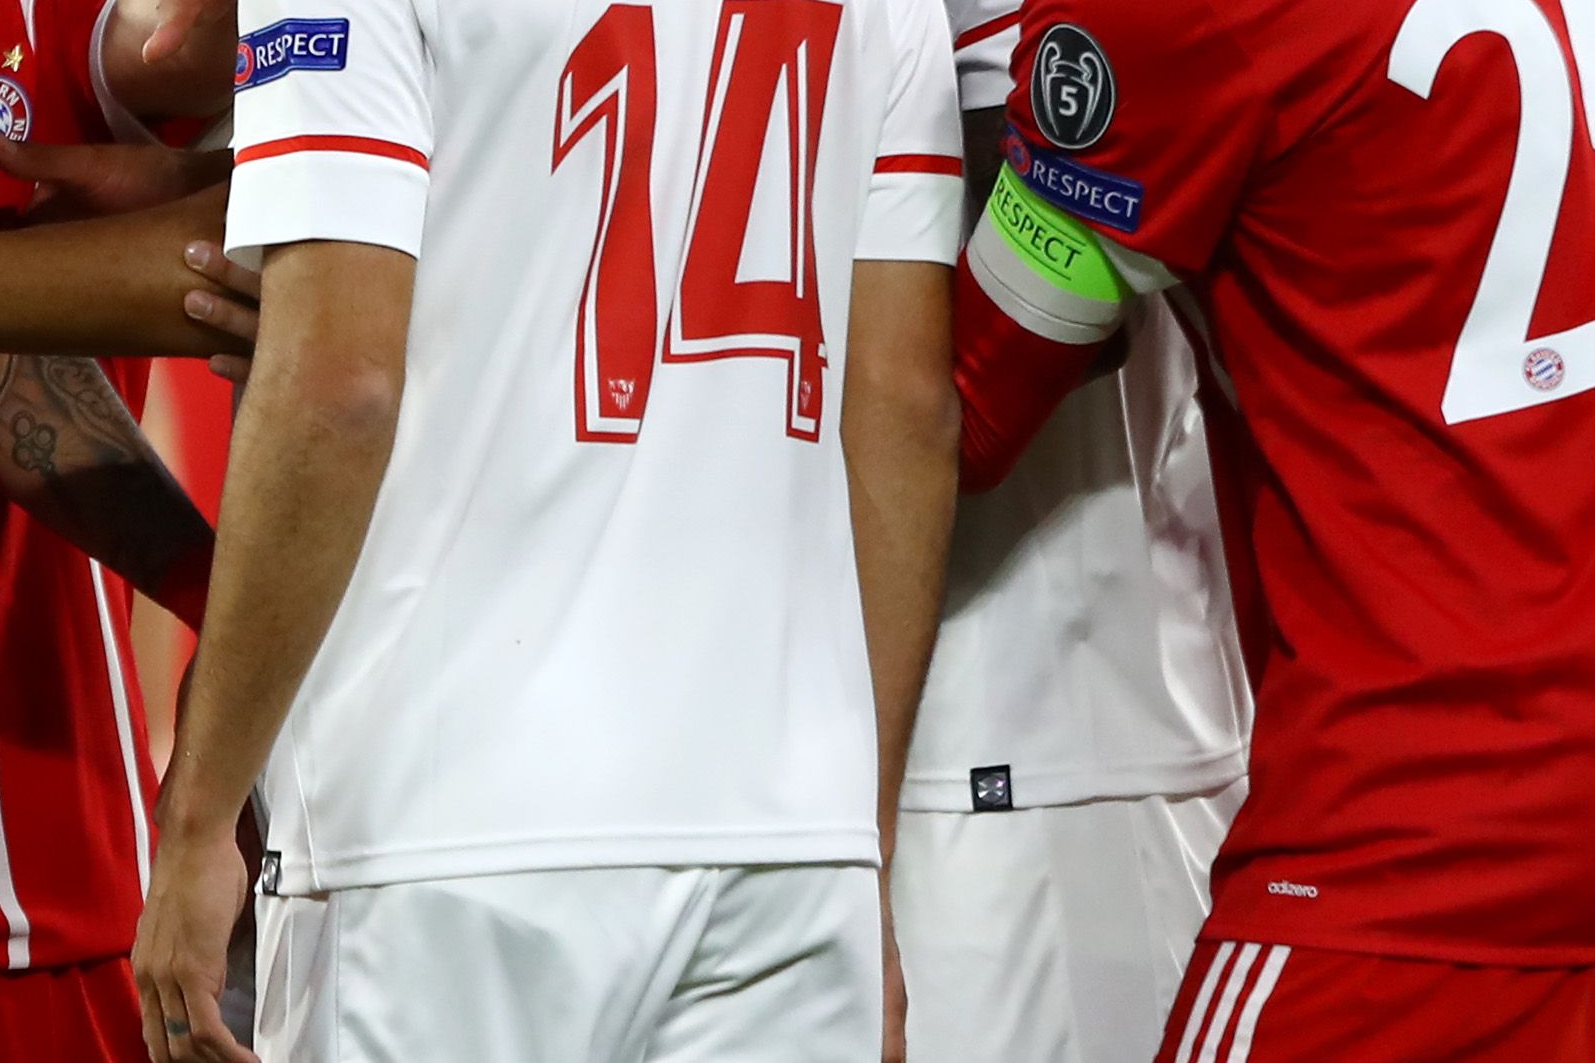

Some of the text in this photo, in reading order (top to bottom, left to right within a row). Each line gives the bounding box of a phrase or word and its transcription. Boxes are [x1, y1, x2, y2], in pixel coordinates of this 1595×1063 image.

[255, 33, 345, 69] RESPECT
[1059, 85, 1079, 116] 5
[1033, 159, 1140, 219] RESPECT
[995, 177, 1083, 270] RESPECT
[1268, 880, 1319, 898] adizero
